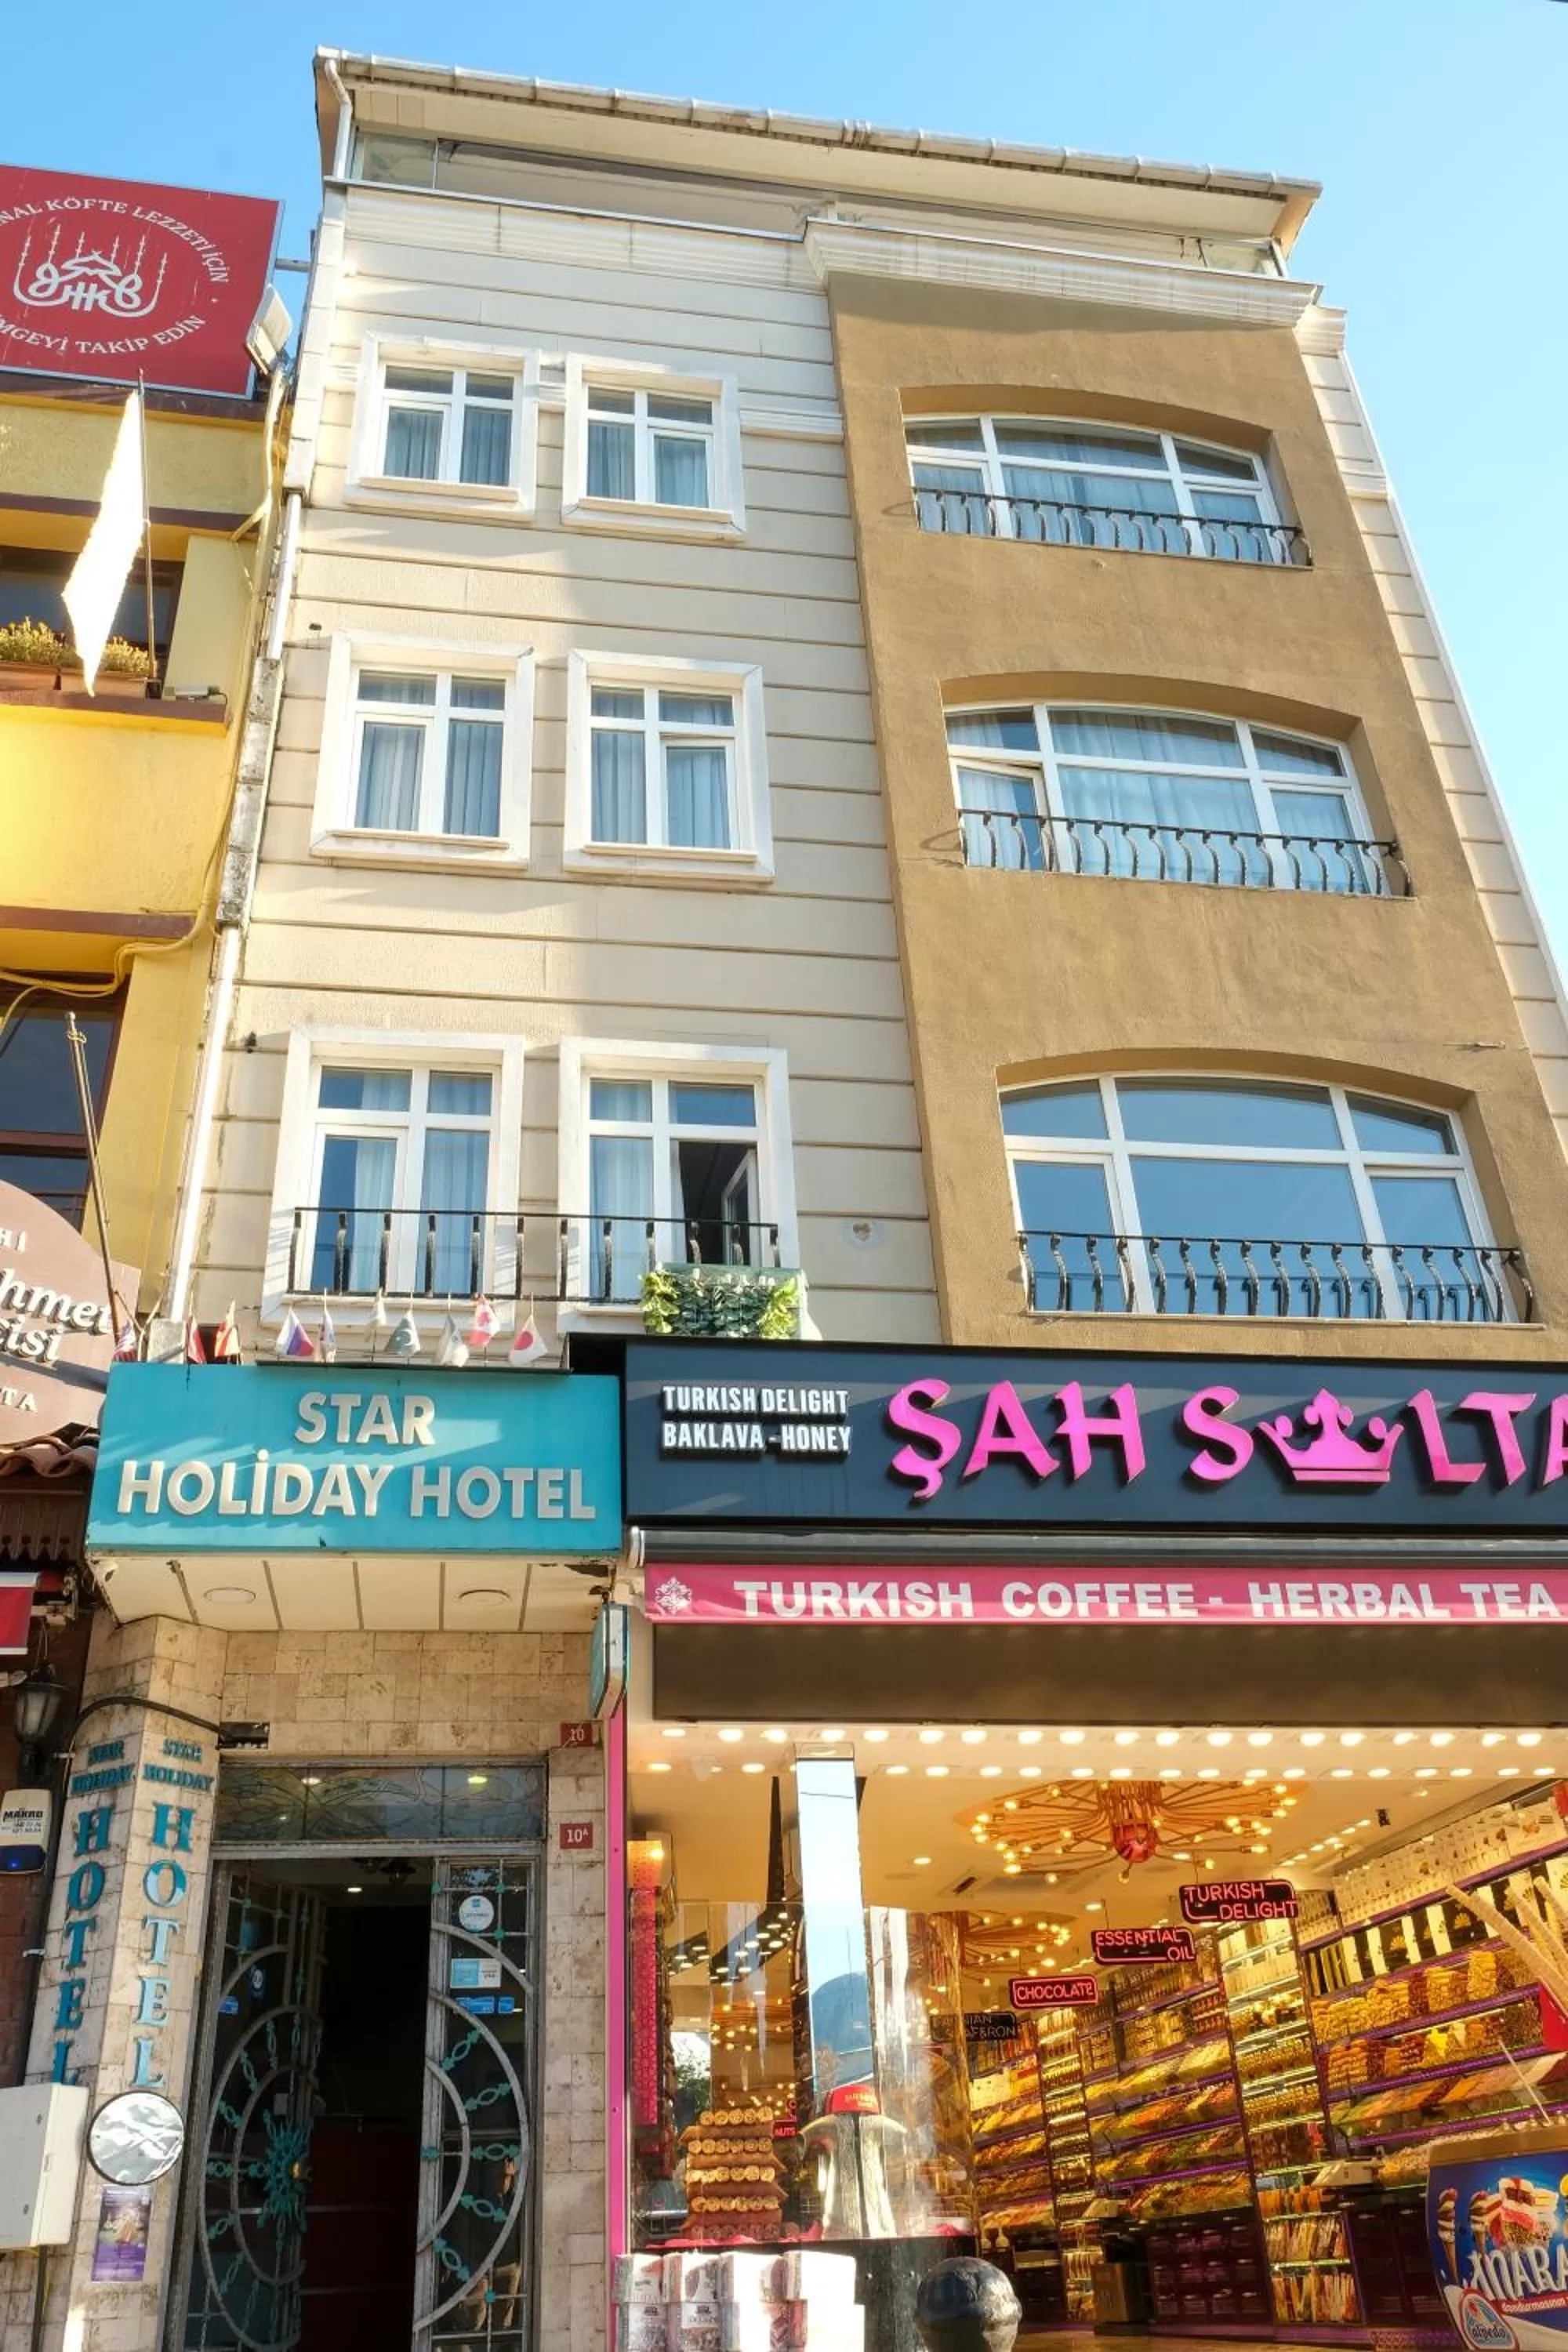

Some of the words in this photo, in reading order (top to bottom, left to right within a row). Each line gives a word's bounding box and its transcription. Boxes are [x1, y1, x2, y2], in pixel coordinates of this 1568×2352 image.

[45, 196, 127, 214] KÖFTE
[132, 206, 216, 251] LEZZETİ
[75, 338, 149, 354] TAKİP
[153, 314, 206, 346] EDİN
[662, 1386, 757, 1412] TURKISH
[762, 1388, 849, 1414] DELIGHT
[295, 1392, 435, 1445] STAR
[662, 1422, 764, 1450] BAKLAVA
[781, 1425, 851, 1452] HONEY
[887, 1378, 1145, 1498] ŞAH
[410, 1465, 596, 1519] HOTEL
[734, 1581, 971, 1617] TURKISH
[1001, 1582, 1198, 1617] COFFEE
[1248, 1582, 1451, 1618] HERBAL
[1459, 1583, 1562, 1618] TEA
[569, 1728, 584, 1741] 10
[162, 1738, 202, 1763] STAR
[143, 1763, 214, 1791] HOLIDAY
[1185, 1883, 1265, 1903] TURKISH
[1219, 1900, 1298, 1920] DELIGHT
[131, 1802, 195, 2088] HOTEL
[1095, 1929, 1182, 1946] ESSENTIAL
[1167, 1947, 1195, 1962] OIL
[1016, 1982, 1094, 2001] CHOCOLATE
